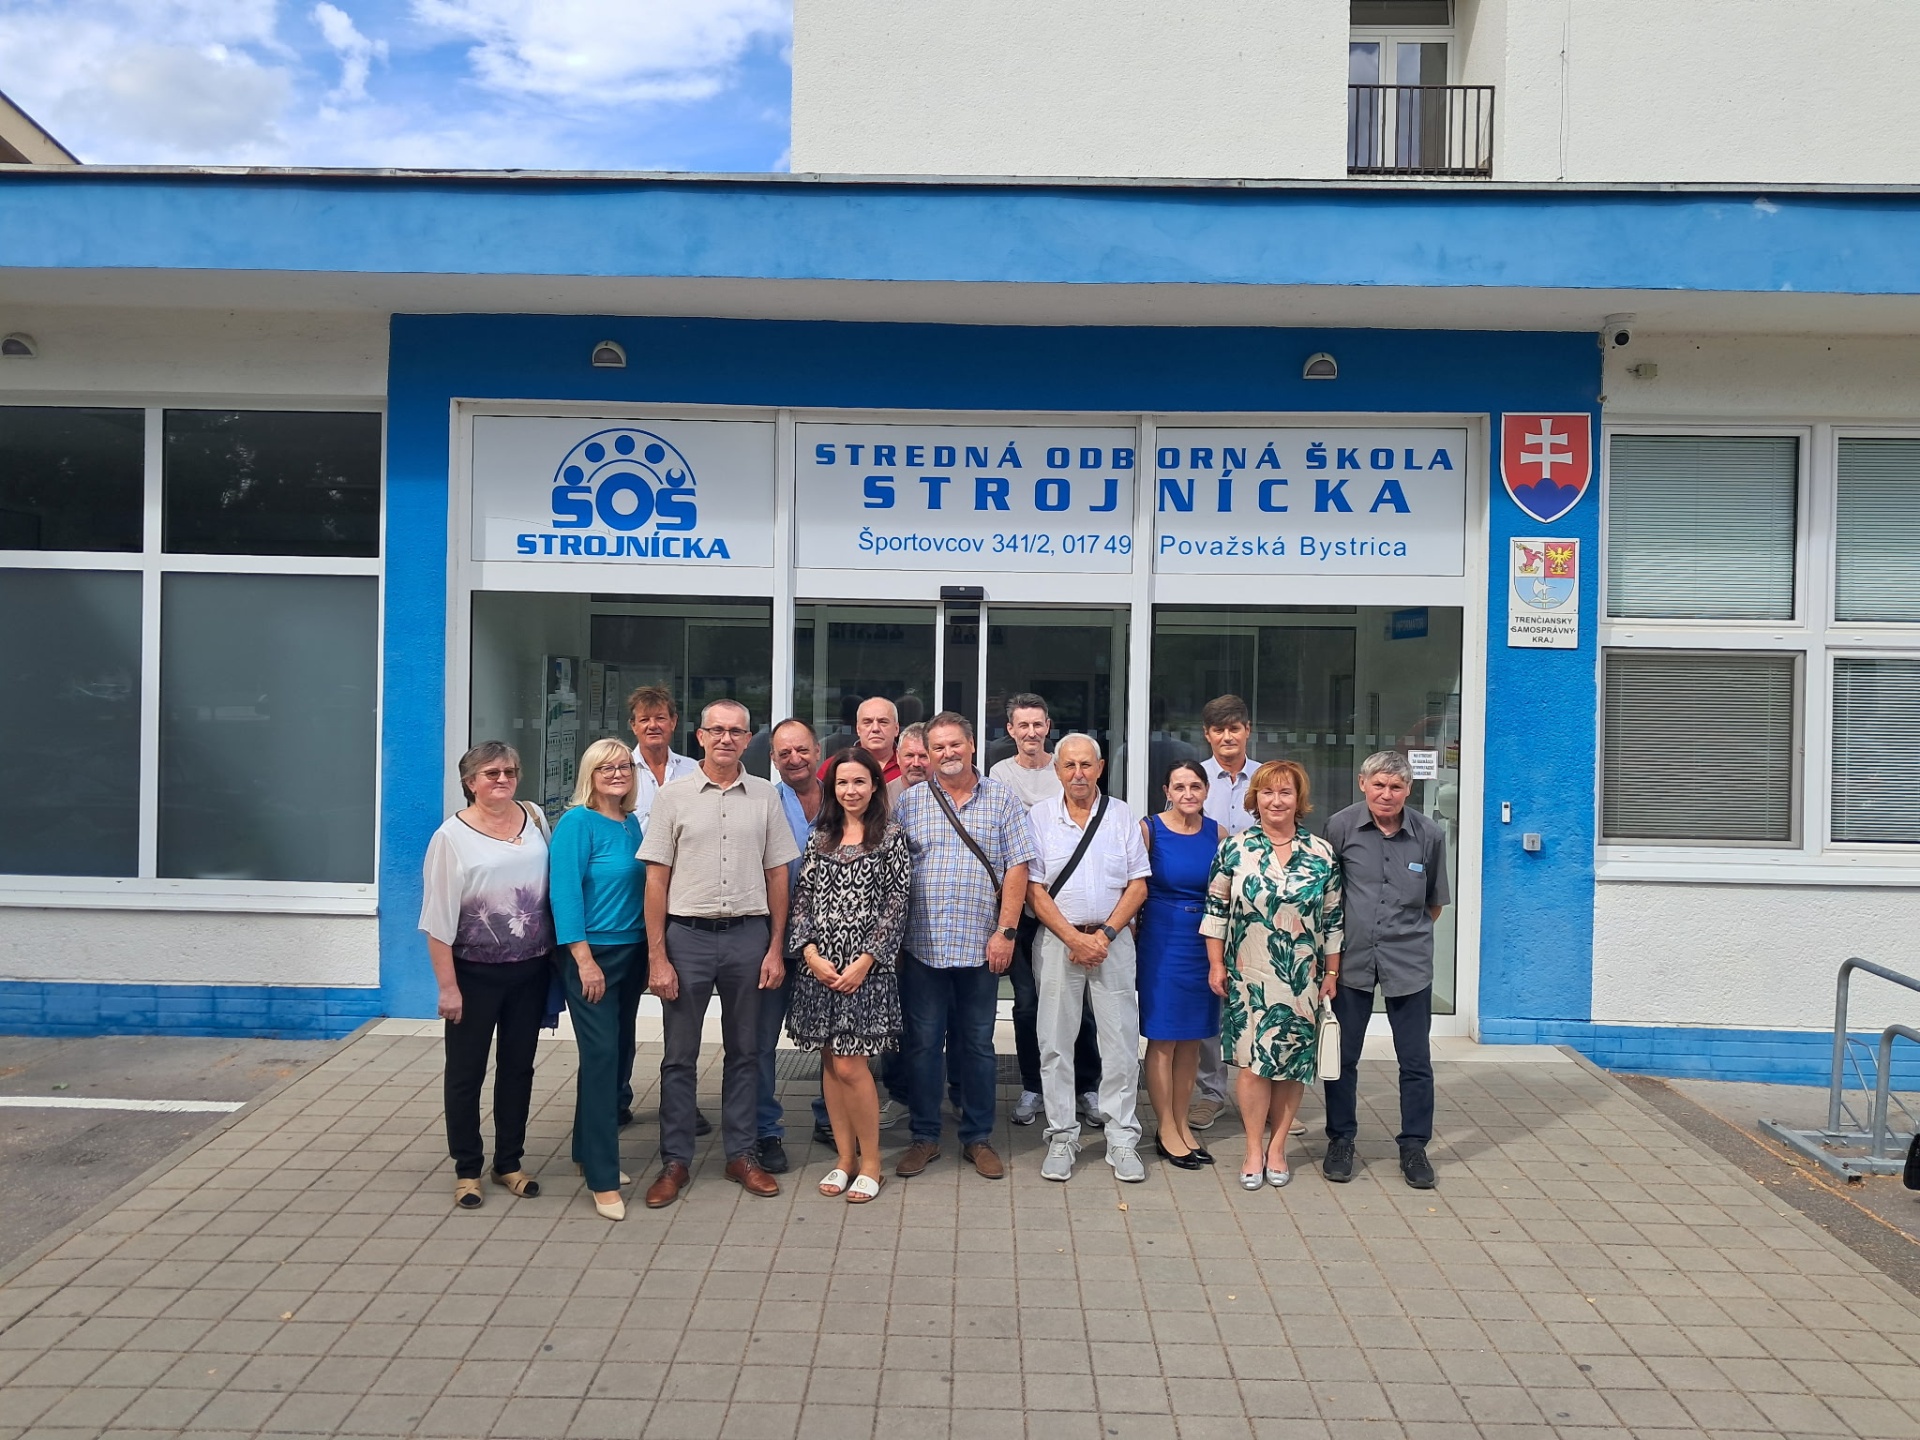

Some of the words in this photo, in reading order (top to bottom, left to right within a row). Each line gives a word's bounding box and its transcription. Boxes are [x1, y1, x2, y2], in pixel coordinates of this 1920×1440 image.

[815, 441, 1023, 469] STREDNÁ
[1306, 442, 1454, 471] ŠKOLA
[516, 531, 731, 559] STROJNÍCKA
[858, 527, 984, 555] Športovcov
[992, 533, 1055, 557] 341/2,
[1160, 535, 1286, 556] Považská
[1300, 536, 1407, 560] Bystrica
[1511, 625, 1575, 634] SAMOSPRÁVNY
[1514, 615, 1573, 625] TRENČIANSKY
[1532, 636, 1554, 644] KRAJ
